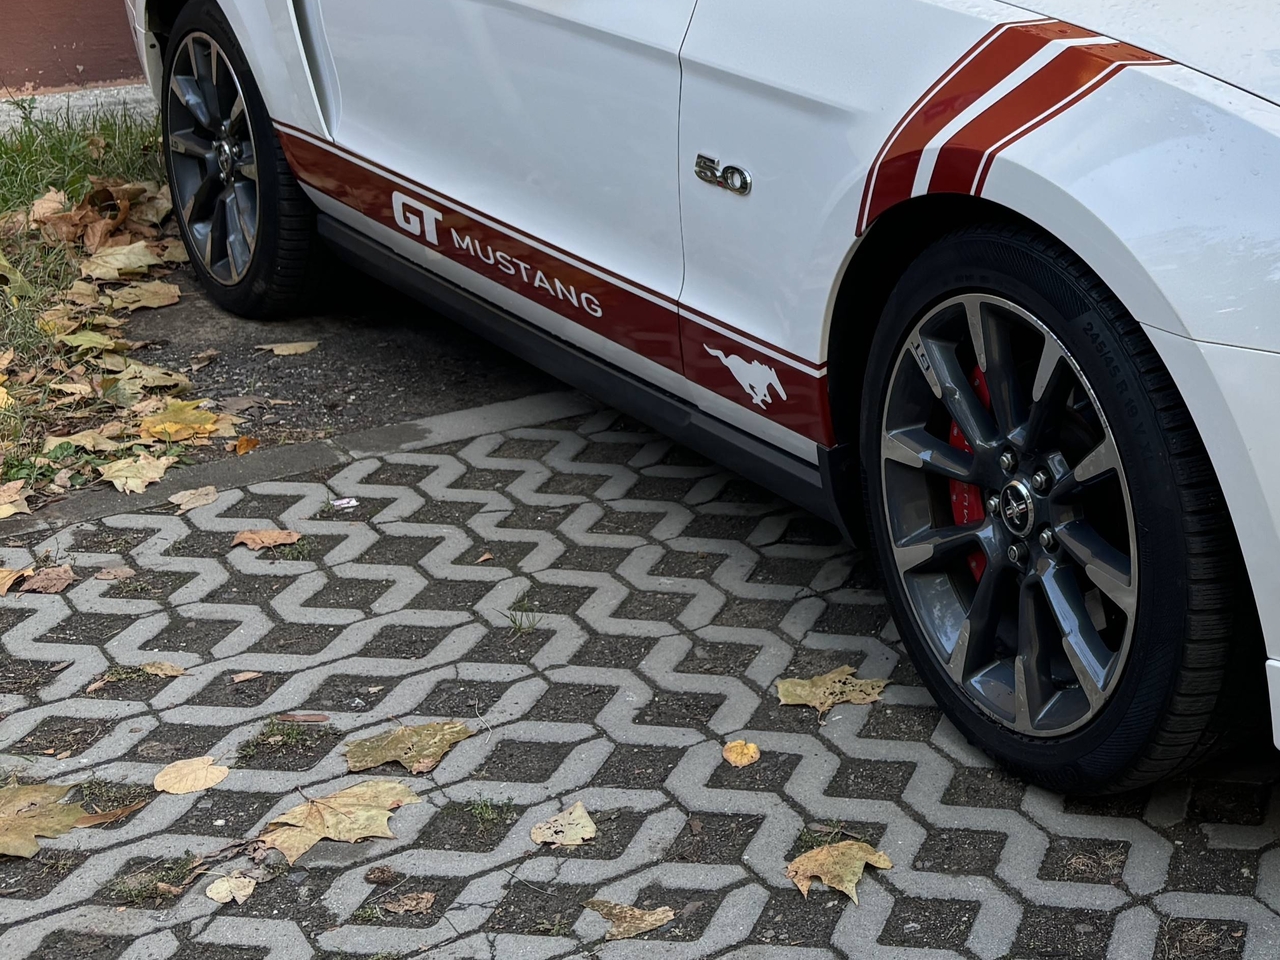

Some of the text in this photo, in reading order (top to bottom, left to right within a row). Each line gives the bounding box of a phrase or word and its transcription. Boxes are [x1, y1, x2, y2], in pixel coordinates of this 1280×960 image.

[694, 153, 753, 196] 5.0
[392, 191, 603, 318] GT MUSTANG
[1083, 322, 1121, 378] 245/45
[1124, 398, 1138, 418] 19
